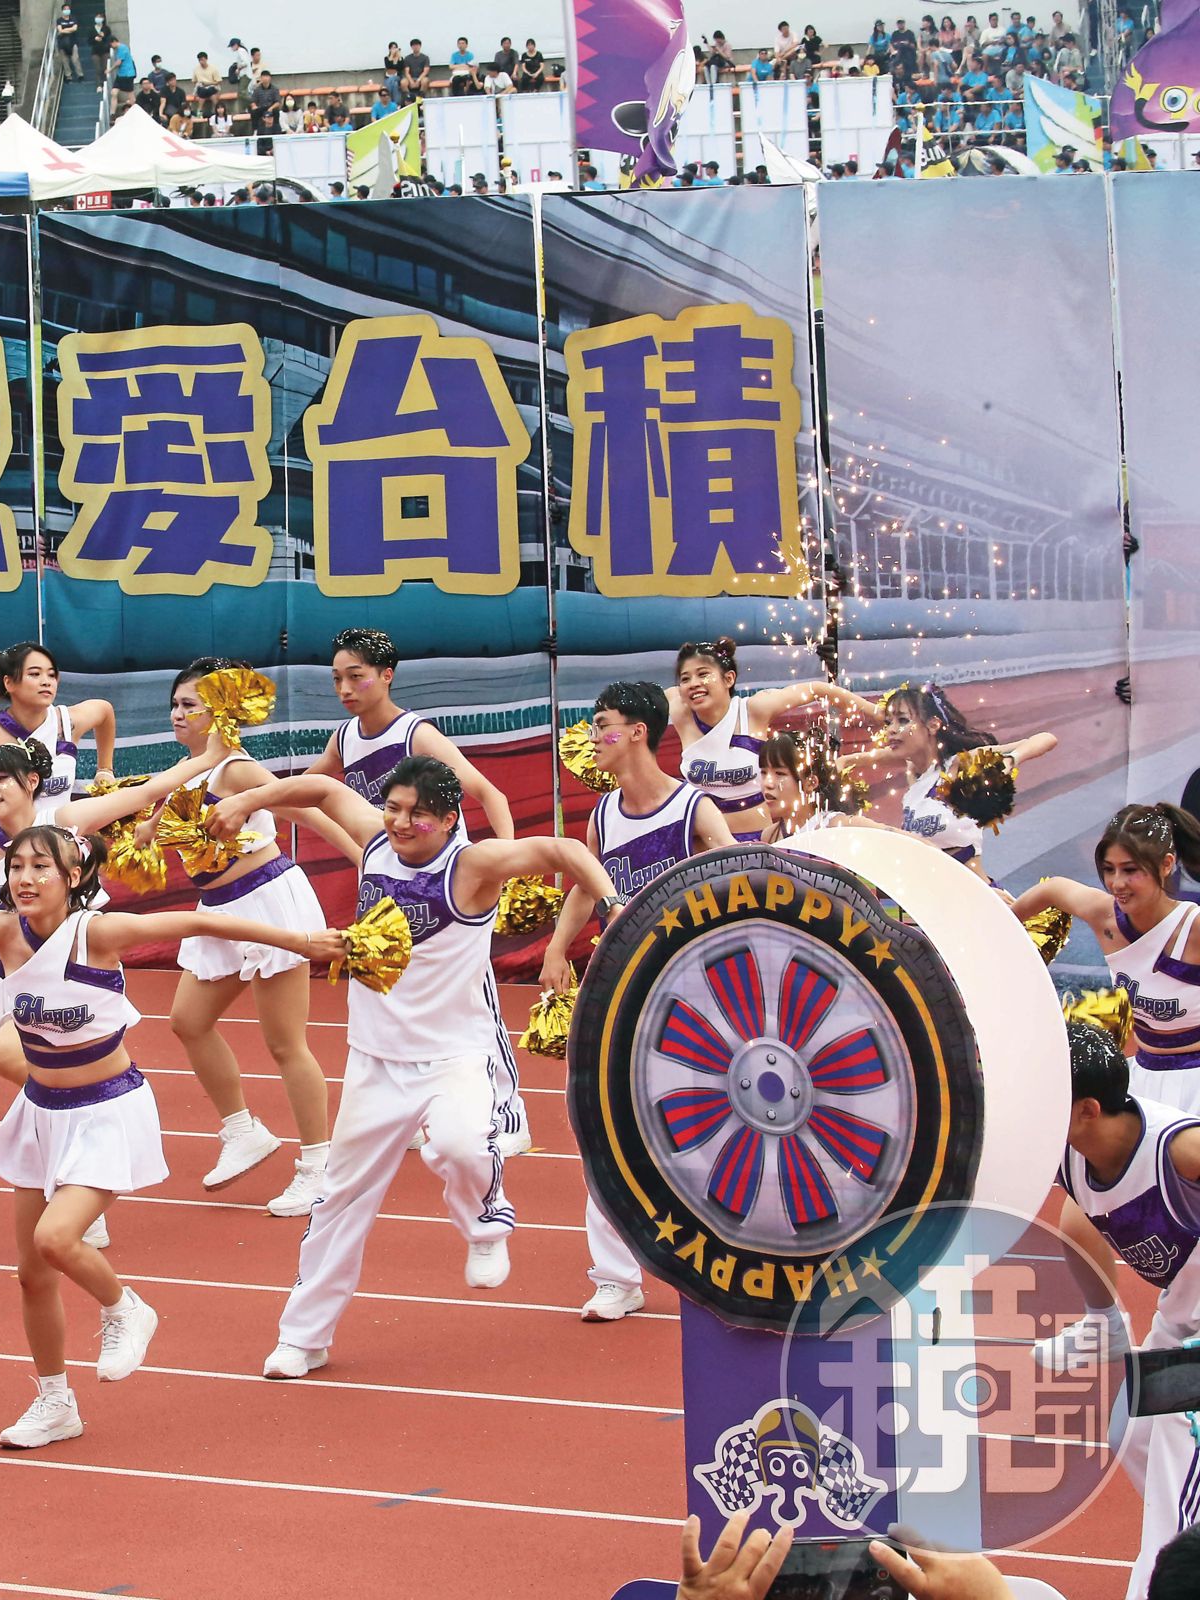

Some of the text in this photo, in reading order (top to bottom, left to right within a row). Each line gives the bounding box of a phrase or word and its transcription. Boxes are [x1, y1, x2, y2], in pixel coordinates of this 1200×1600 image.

[687, 759, 757, 786] Happy
[683, 874, 871, 948] HAPPY
[13, 993, 95, 1032] Happy
[674, 1231, 859, 1301] HAPPY
[1102, 1231, 1179, 1275] appy
